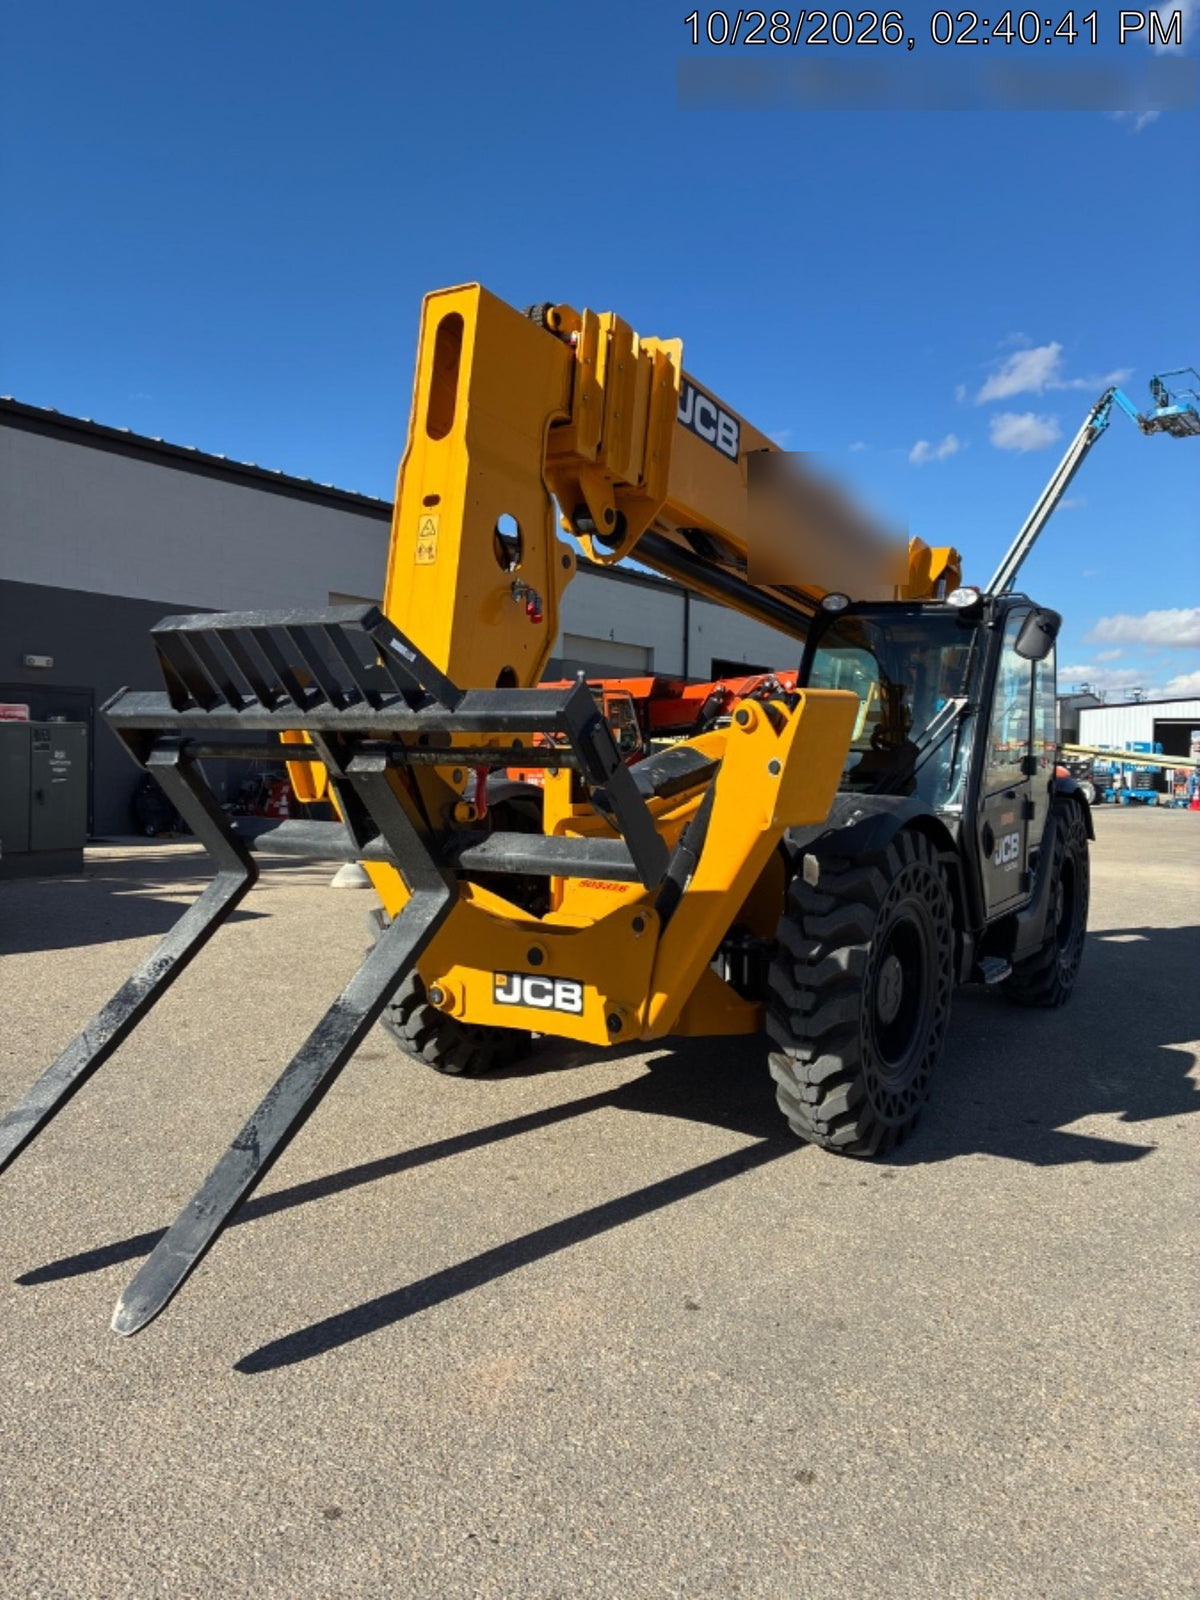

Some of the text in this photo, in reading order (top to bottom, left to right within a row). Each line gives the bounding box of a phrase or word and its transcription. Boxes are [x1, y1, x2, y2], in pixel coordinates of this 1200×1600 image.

[677, 385, 739, 458] JCB
[995, 832, 1020, 866] JCB
[495, 973, 583, 1013] JCB
